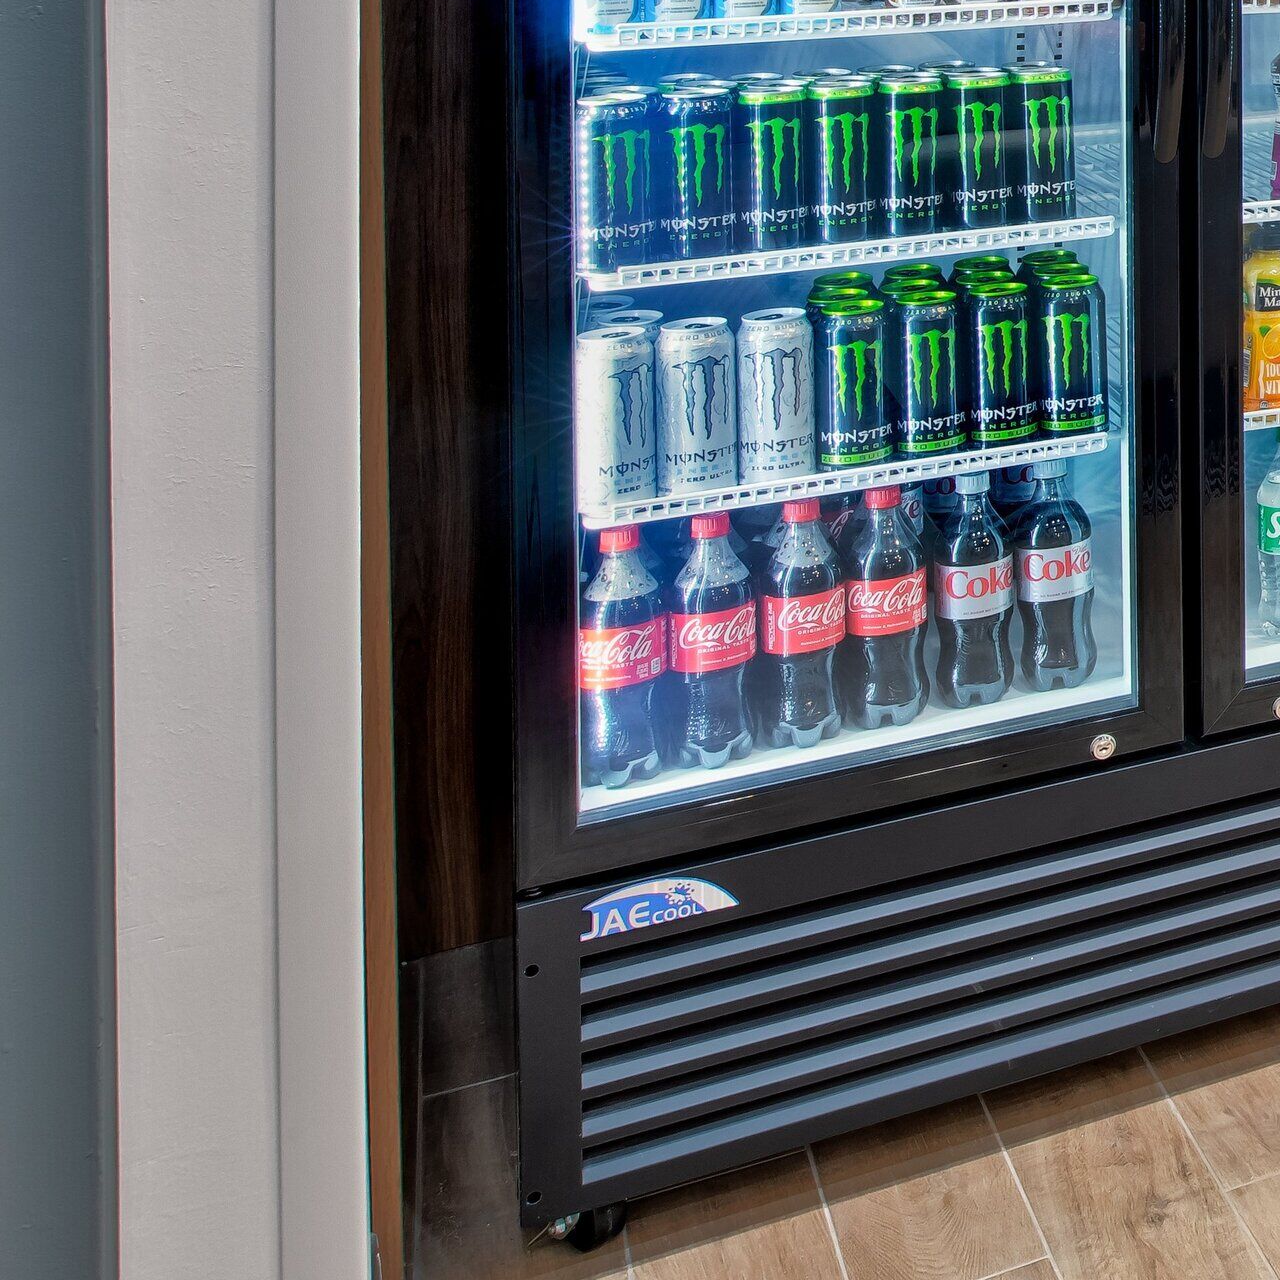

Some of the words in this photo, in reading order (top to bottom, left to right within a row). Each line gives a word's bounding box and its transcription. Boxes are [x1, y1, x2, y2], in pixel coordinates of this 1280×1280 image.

[660, 212, 737, 231] MONSTER
[971, 400, 1038, 422] MONSTER
[821, 422, 893, 445] MONSTER
[898, 411, 966, 434] MONSTER
[740, 432, 814, 454] MONSTER
[1023, 550, 1091, 582] Coke
[848, 573, 924, 614] Coca-Cola
[945, 566, 1013, 599] Coke
[892, 607, 912, 616] TASTE
[797, 625, 829, 635] ORIGINAL
